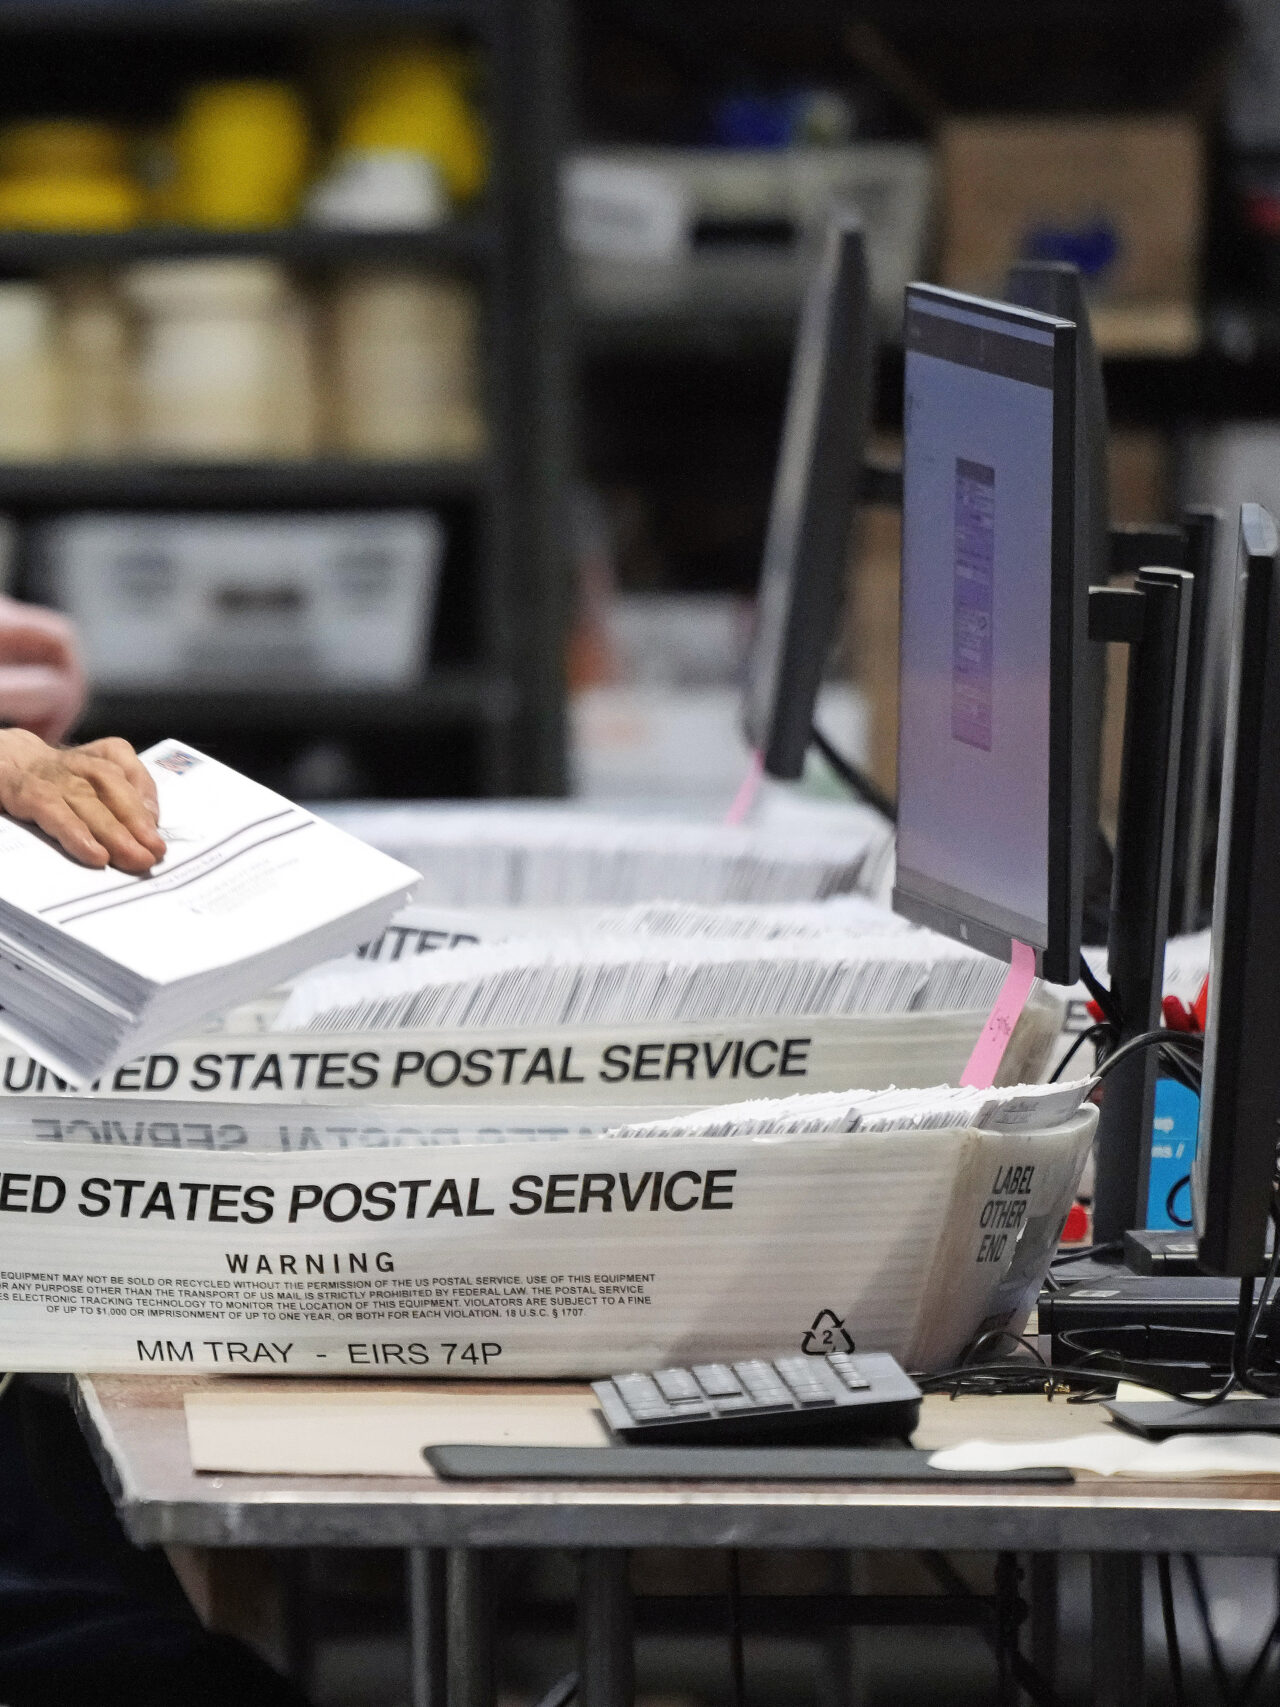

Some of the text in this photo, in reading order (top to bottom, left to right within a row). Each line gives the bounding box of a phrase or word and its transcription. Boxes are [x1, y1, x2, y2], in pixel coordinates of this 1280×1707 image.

[3, 1039, 812, 1092] UNED STATES POSTAL SERVICE
[991, 1166, 1035, 1194] LABEL
[78, 1177, 276, 1225] STATES
[287, 1177, 496, 1223] POSTAL
[508, 1169, 739, 1216] SERVICE
[980, 1200, 1027, 1228] OTHER
[976, 1234, 1008, 1262] END
[225, 1252, 396, 1274] WARNING
[0, 1271, 60, 1282] EQUIPMENT
[62, 1274, 84, 1283] MAY
[86, 1275, 108, 1285] NOT
[110, 1276, 125, 1285] BE
[126, 1277, 156, 1287] SOLD
[158, 1278, 173, 1287] OR
[175, 1279, 231, 1289] RECYCLED
[233, 1280, 281, 1289] WITHOUT
[284, 1281, 305, 1289] THE
[307, 1280, 372, 1289] PERMISSION
[374, 1280, 389, 1288] OF
[391, 1279, 414, 1288] THE
[415, 1278, 430, 1287] US
[432, 1277, 474, 1287] POSTAL
[526, 1275, 548, 1284] USE
[550, 1274, 565, 1283] OF
[568, 1274, 592, 1283] THIS
[594, 1274, 656, 1283] EQUIPMENT
[11, 1282, 32, 1291] ANY
[35, 1283, 84, 1294] PURPOSE
[86, 1285, 122, 1295] OTHER
[124, 1287, 153, 1297] THAN
[154, 1288, 175, 1297] THE
[178, 1289, 240, 1299] TRANSPORT
[243, 1290, 257, 1299] OF
[260, 1291, 275, 1299] US
[277, 1291, 302, 1299] MAIL
[304, 1291, 316, 1299] IS
[317, 1290, 366, 1299] STRICTLY
[369, 1289, 433, 1299] PROHIBITED
[435, 1288, 449, 1297] BY
[452, 1287, 500, 1297] FEDERAL
[531, 1286, 552, 1295] THE
[555, 1285, 597, 1294] POSTAL
[599, 1285, 644, 1295] SERVICE
[12, 1293, 77, 1304] ELECTRONIC
[80, 1296, 133, 1306] TRACKING
[134, 1298, 207, 1308] TECHNOLOGY
[209, 1300, 224, 1309] TO
[226, 1300, 274, 1310] MONITOR
[276, 1301, 298, 1310] THE
[299, 1301, 353, 1310] LOCATION
[355, 1301, 369, 1309] OF
[372, 1300, 396, 1309] THIS
[464, 1297, 524, 1307] VIOLATORS
[526, 1297, 548, 1306] ARE
[550, 1296, 598, 1306] SUBJECT
[601, 1296, 616, 1305] TO
[618, 1296, 626, 1305] A
[628, 1296, 652, 1305] FINE
[46, 1305, 60, 1314] OF
[63, 1305, 77, 1314] UP
[79, 1306, 94, 1315] TO
[130, 1308, 145, 1317] OR
[148, 1309, 226, 1320] IMPRISONMENT
[228, 1311, 243, 1320] OF
[245, 1311, 260, 1320] UP
[262, 1312, 277, 1320] TO
[278, 1312, 301, 1321] ONE
[338, 1312, 354, 1320] OR
[356, 1311, 386, 1320] BOTH
[388, 1311, 410, 1320] FOR
[412, 1310, 442, 1319] EACH
[505, 1309, 517, 1317] 18
[822, 1330, 834, 1345] 2
[136, 1340, 194, 1362] MM
[203, 1341, 294, 1363] TRAY
[347, 1343, 430, 1365] EIRS
[439, 1342, 504, 1366] 74P
